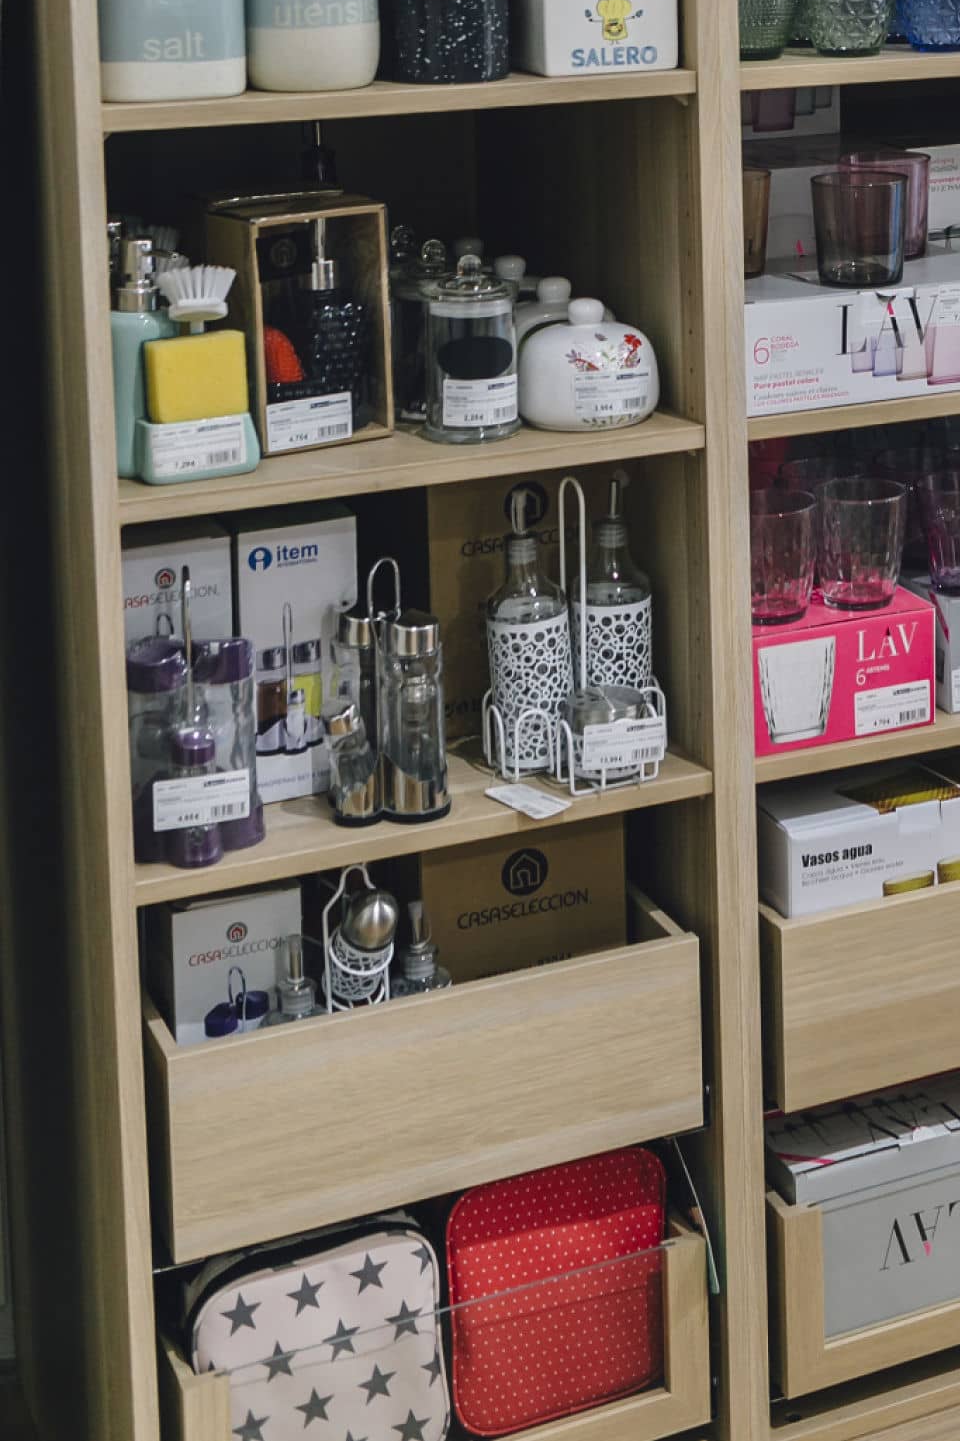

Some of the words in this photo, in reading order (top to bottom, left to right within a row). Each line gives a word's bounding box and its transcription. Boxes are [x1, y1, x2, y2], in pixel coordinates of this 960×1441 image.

[143, 29, 204, 60] salt
[571, 46, 658, 67] SALERO
[836, 292, 939, 356] LAV
[753, 338, 769, 364] 6
[277, 544, 318, 561] item
[856, 622, 918, 662] LAV
[856, 669, 866, 686] 6
[801, 848, 839, 868] Vasos
[842, 843, 873, 862] agua
[457, 890, 589, 931] CASASELECCION
